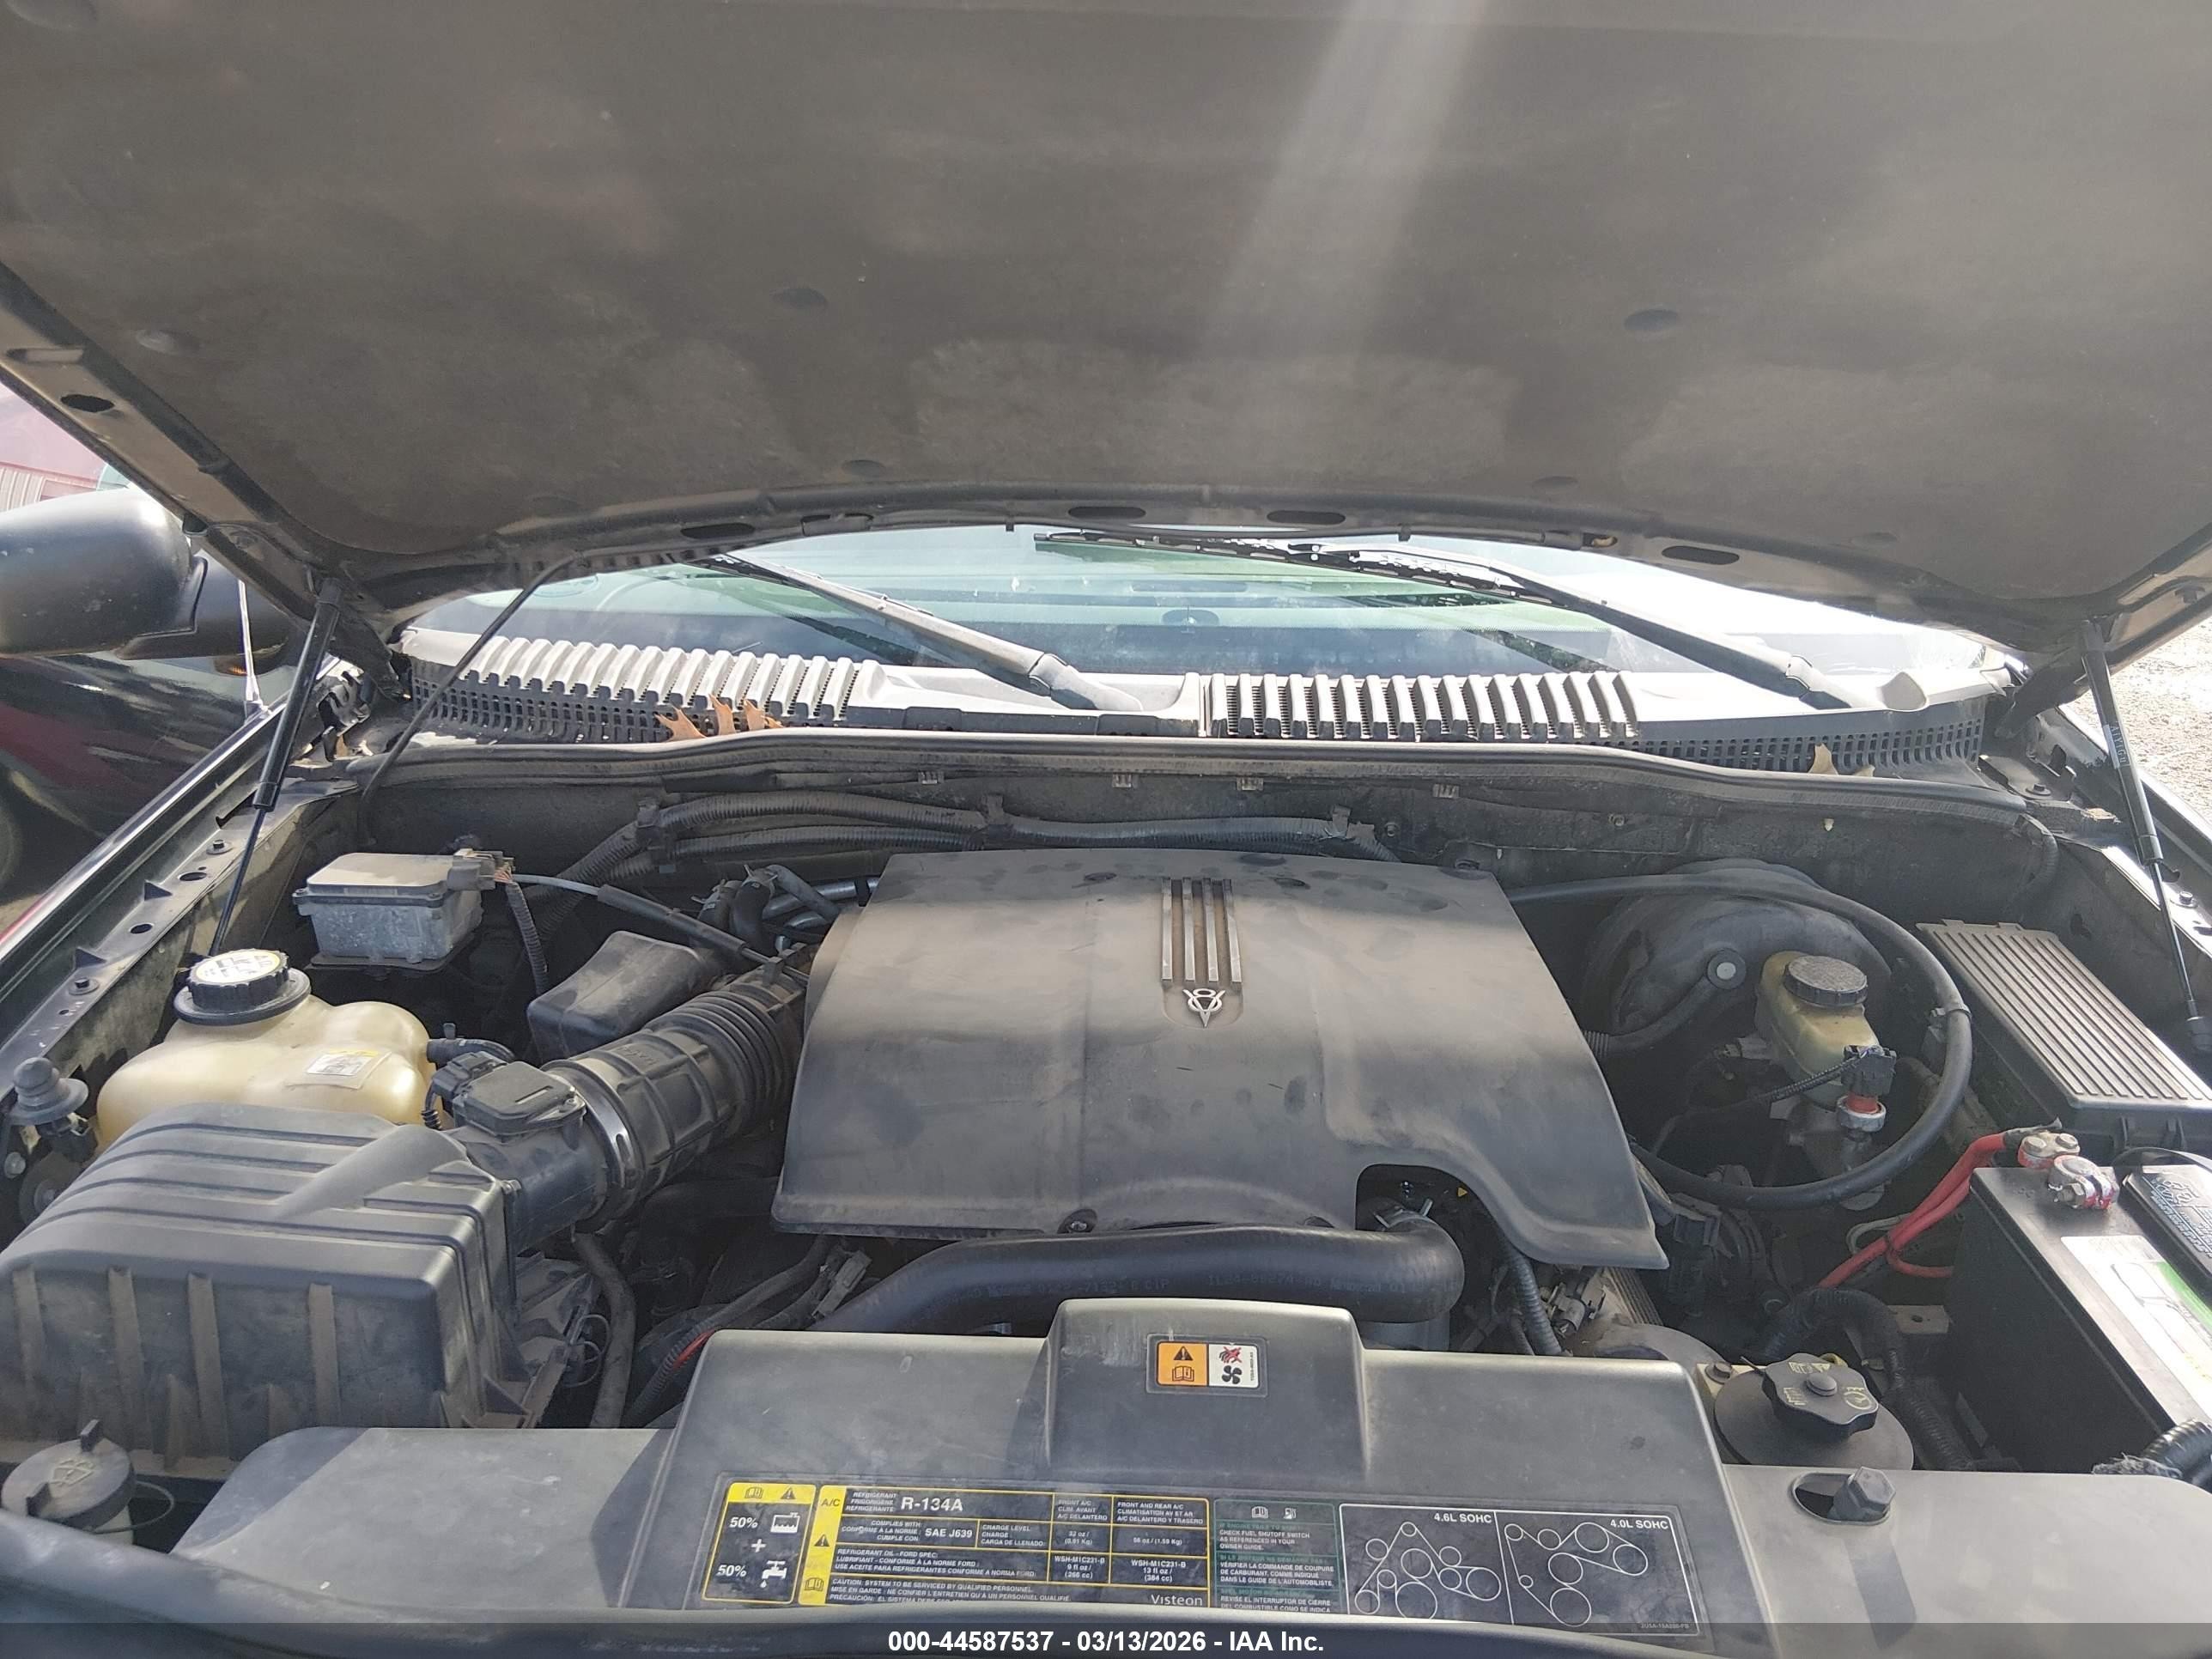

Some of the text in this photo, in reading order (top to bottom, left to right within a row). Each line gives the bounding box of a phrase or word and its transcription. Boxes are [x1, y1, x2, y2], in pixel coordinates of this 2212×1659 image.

[821, 1498, 841, 1507] A/C
[902, 1497, 963, 1511] R-134A
[729, 1516, 758, 1528] 50%
[1434, 1513, 1492, 1523] 4.6L SOHC
[1610, 1519, 1668, 1529] 4.0L SOHC
[925, 1528, 973, 1538] SAE J639
[716, 1565, 747, 1577] 50%
[892, 1565, 946, 1574] REFRIGERANTES
[1151, 1595, 1203, 1606] Visteon
